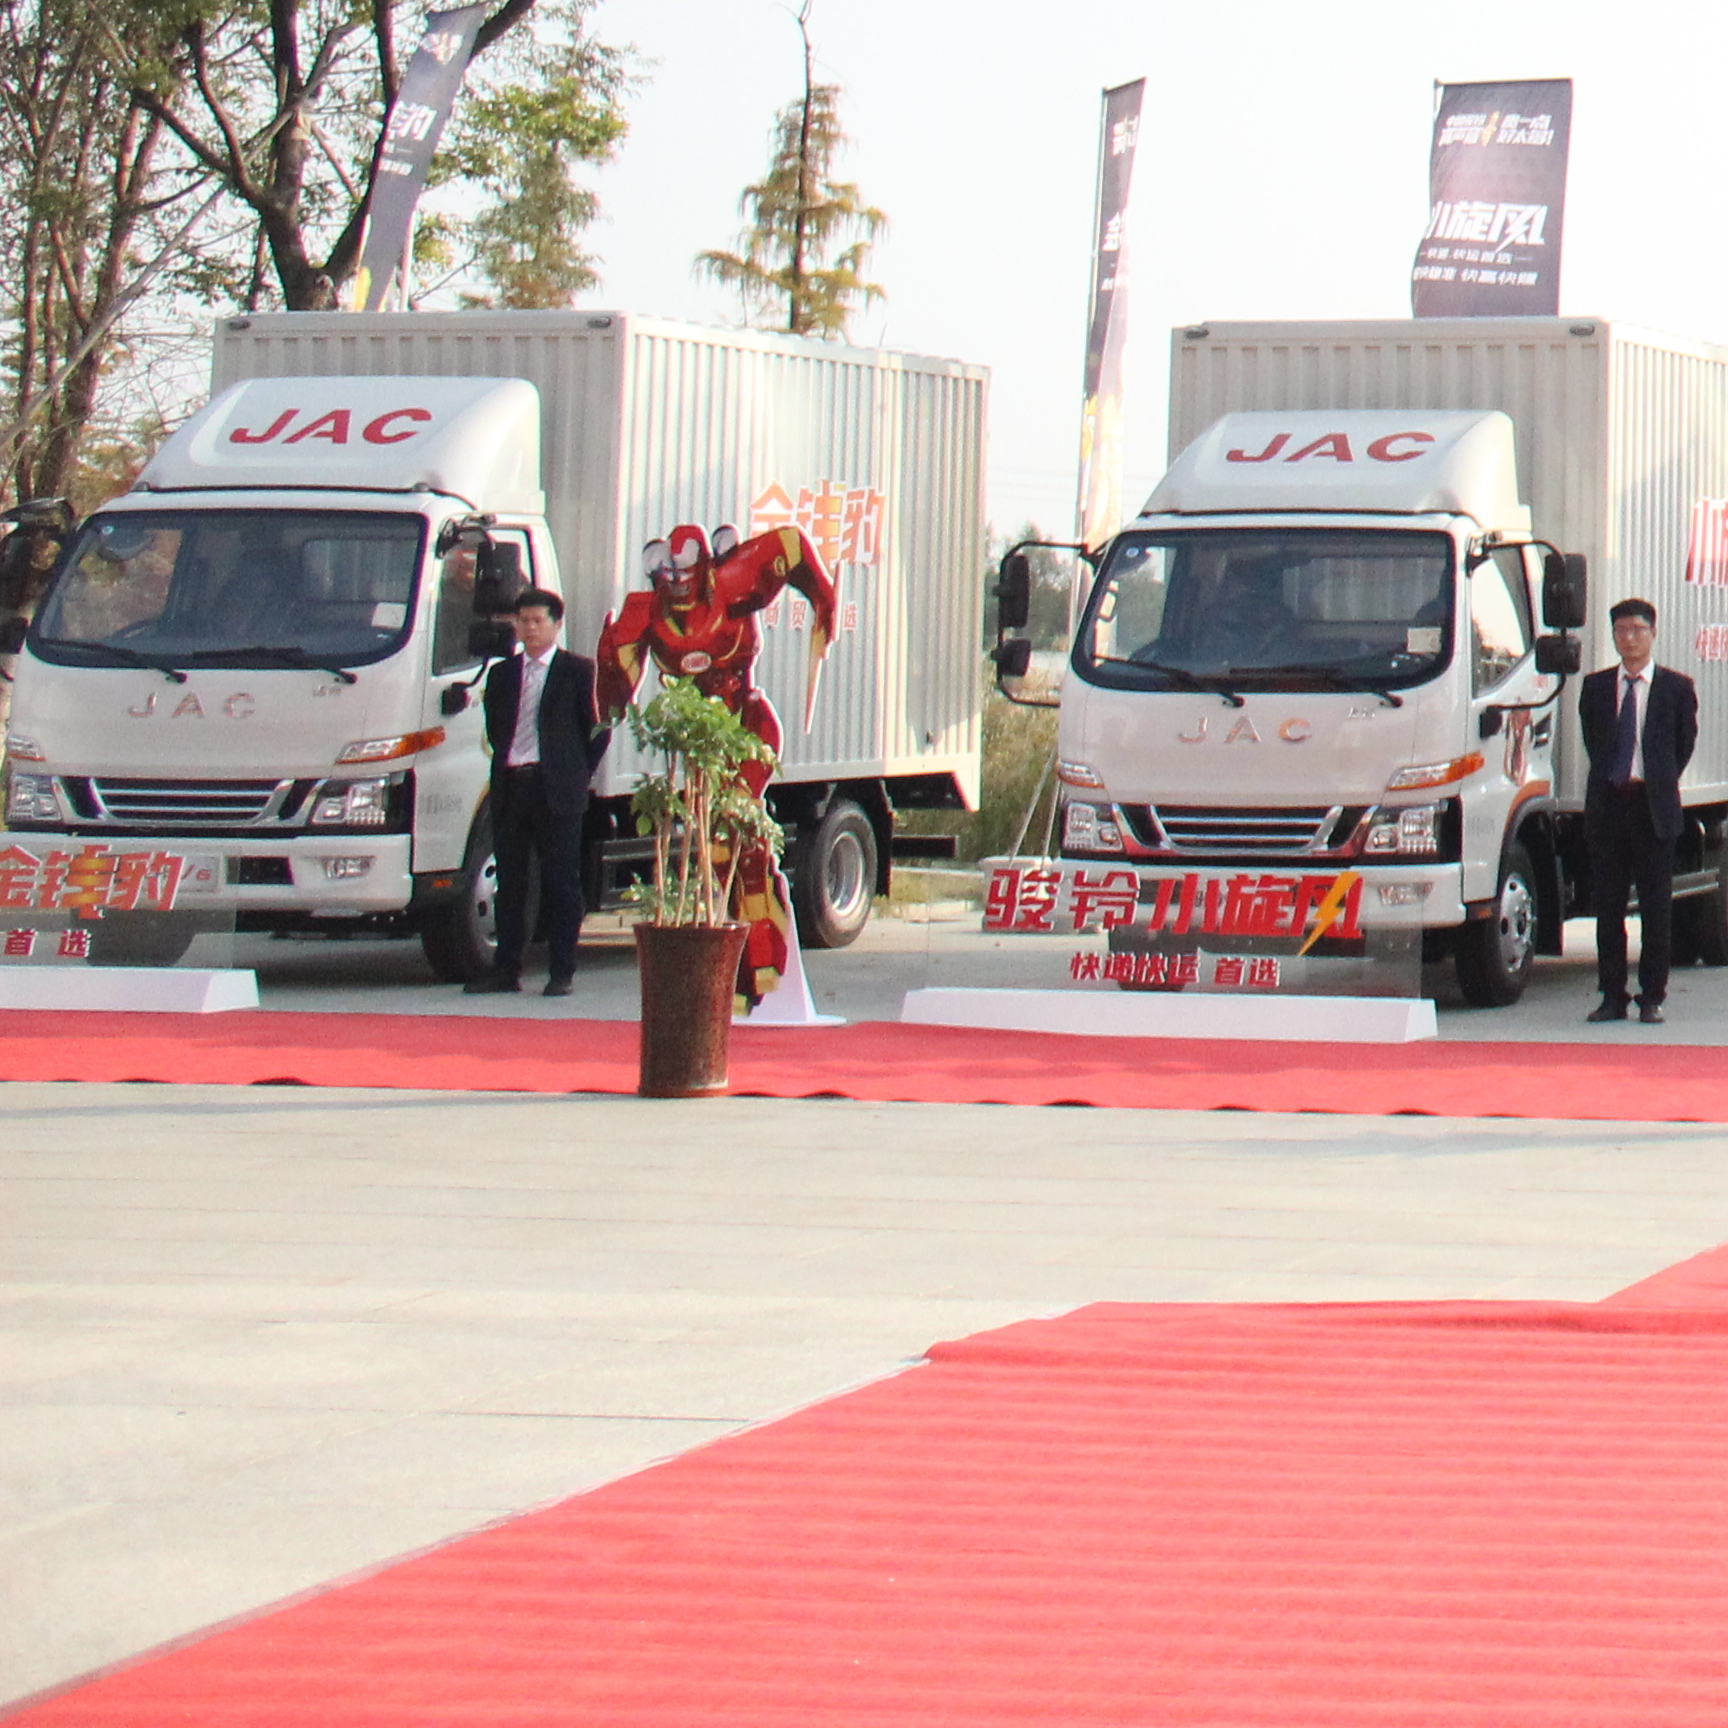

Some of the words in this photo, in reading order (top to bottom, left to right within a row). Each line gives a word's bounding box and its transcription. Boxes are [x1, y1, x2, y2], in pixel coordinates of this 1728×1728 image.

[1425, 201, 1548, 250] 小旋风
[229, 408, 433, 445] JAC
[1226, 431, 1436, 462] JAC
[764, 598, 858, 631] 商贸选
[126, 690, 256, 719] JAC
[1177, 713, 1313, 744] JAC
[982, 868, 1365, 952] 骏铃小旋风
[3, 927, 92, 958] 首选
[1069, 950, 1200, 985] 快递快运
[1213, 956, 1281, 988] 首选
